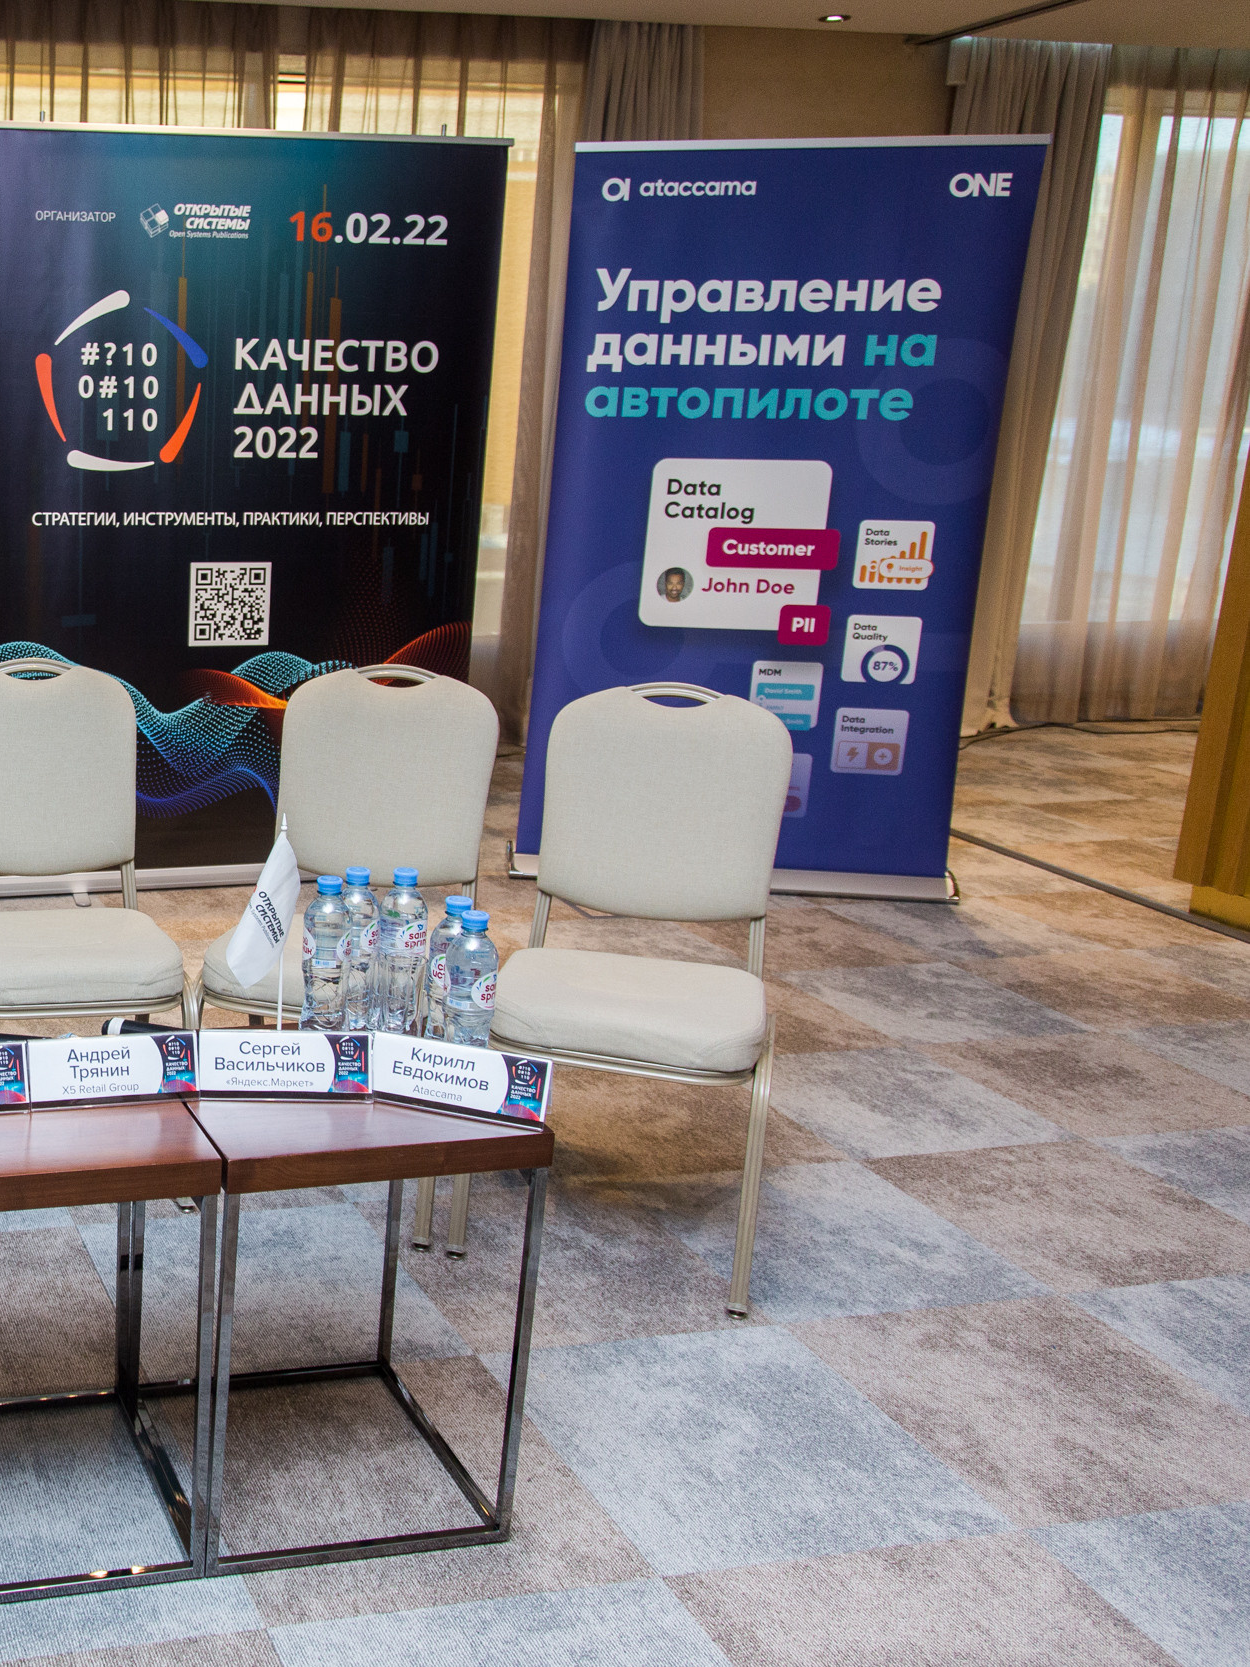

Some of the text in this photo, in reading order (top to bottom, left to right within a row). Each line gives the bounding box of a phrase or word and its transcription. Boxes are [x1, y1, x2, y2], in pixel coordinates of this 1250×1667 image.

[639, 178, 756, 197] ataccama
[949, 172, 1013, 198] ONE
[35, 210, 116, 222] ОРГАНИЗАТОР
[174, 203, 251, 217] ОТКРЫТЫЕ
[186, 217, 250, 230] СИСТЕМЫ
[289, 211, 448, 246] 16.02.22
[169, 230, 249, 239] Open Systems Publications
[596, 268, 942, 323] Управление
[234, 338, 439, 373] КАЧЕСТВО
[586, 333, 938, 373] данными на
[233, 383, 408, 416] ДАННЫХ
[585, 385, 914, 421] автопилоте
[103, 409, 158, 431] 110
[233, 426, 318, 459] 2022
[666, 478, 722, 497] Data
[31, 511, 429, 527] СТРАТЕГИИ, ИНСТРУМЕНТЫ, ПРАКТИКИ, ПЕРСПЕКТИВЫ
[664, 501, 755, 525] Catalog
[864, 537, 898, 547] Stories
[865, 528, 890, 538] Data
[722, 538, 815, 557] Customer
[701, 577, 795, 595] John Doe
[853, 622, 878, 632] Data
[852, 632, 888, 642] Quality
[758, 668, 782, 676] MDM
[873, 661, 899, 672] 87%
[842, 715, 865, 724] Data
[841, 725, 894, 735] Integration
[258, 891, 285, 938] ОТКРЫТЫЕ
[255, 904, 280, 944] СИСТЕМЫ
[404, 939, 427, 949] sprin
[67, 1046, 130, 1064] Андрей
[239, 1041, 301, 1059] Сергей
[214, 1057, 325, 1072] Васильчиков
[411, 1047, 476, 1072] Кирилл
[70, 1065, 130, 1082] Трянин
[226, 1077, 314, 1088] «Яндекс.Маркет»
[392, 1060, 489, 1091] Евдокимов
[62, 1082, 139, 1095] X5 Retail Group
[412, 1084, 463, 1102] Ataccama
[510, 1084, 536, 1094] КАЧЕСТВО
